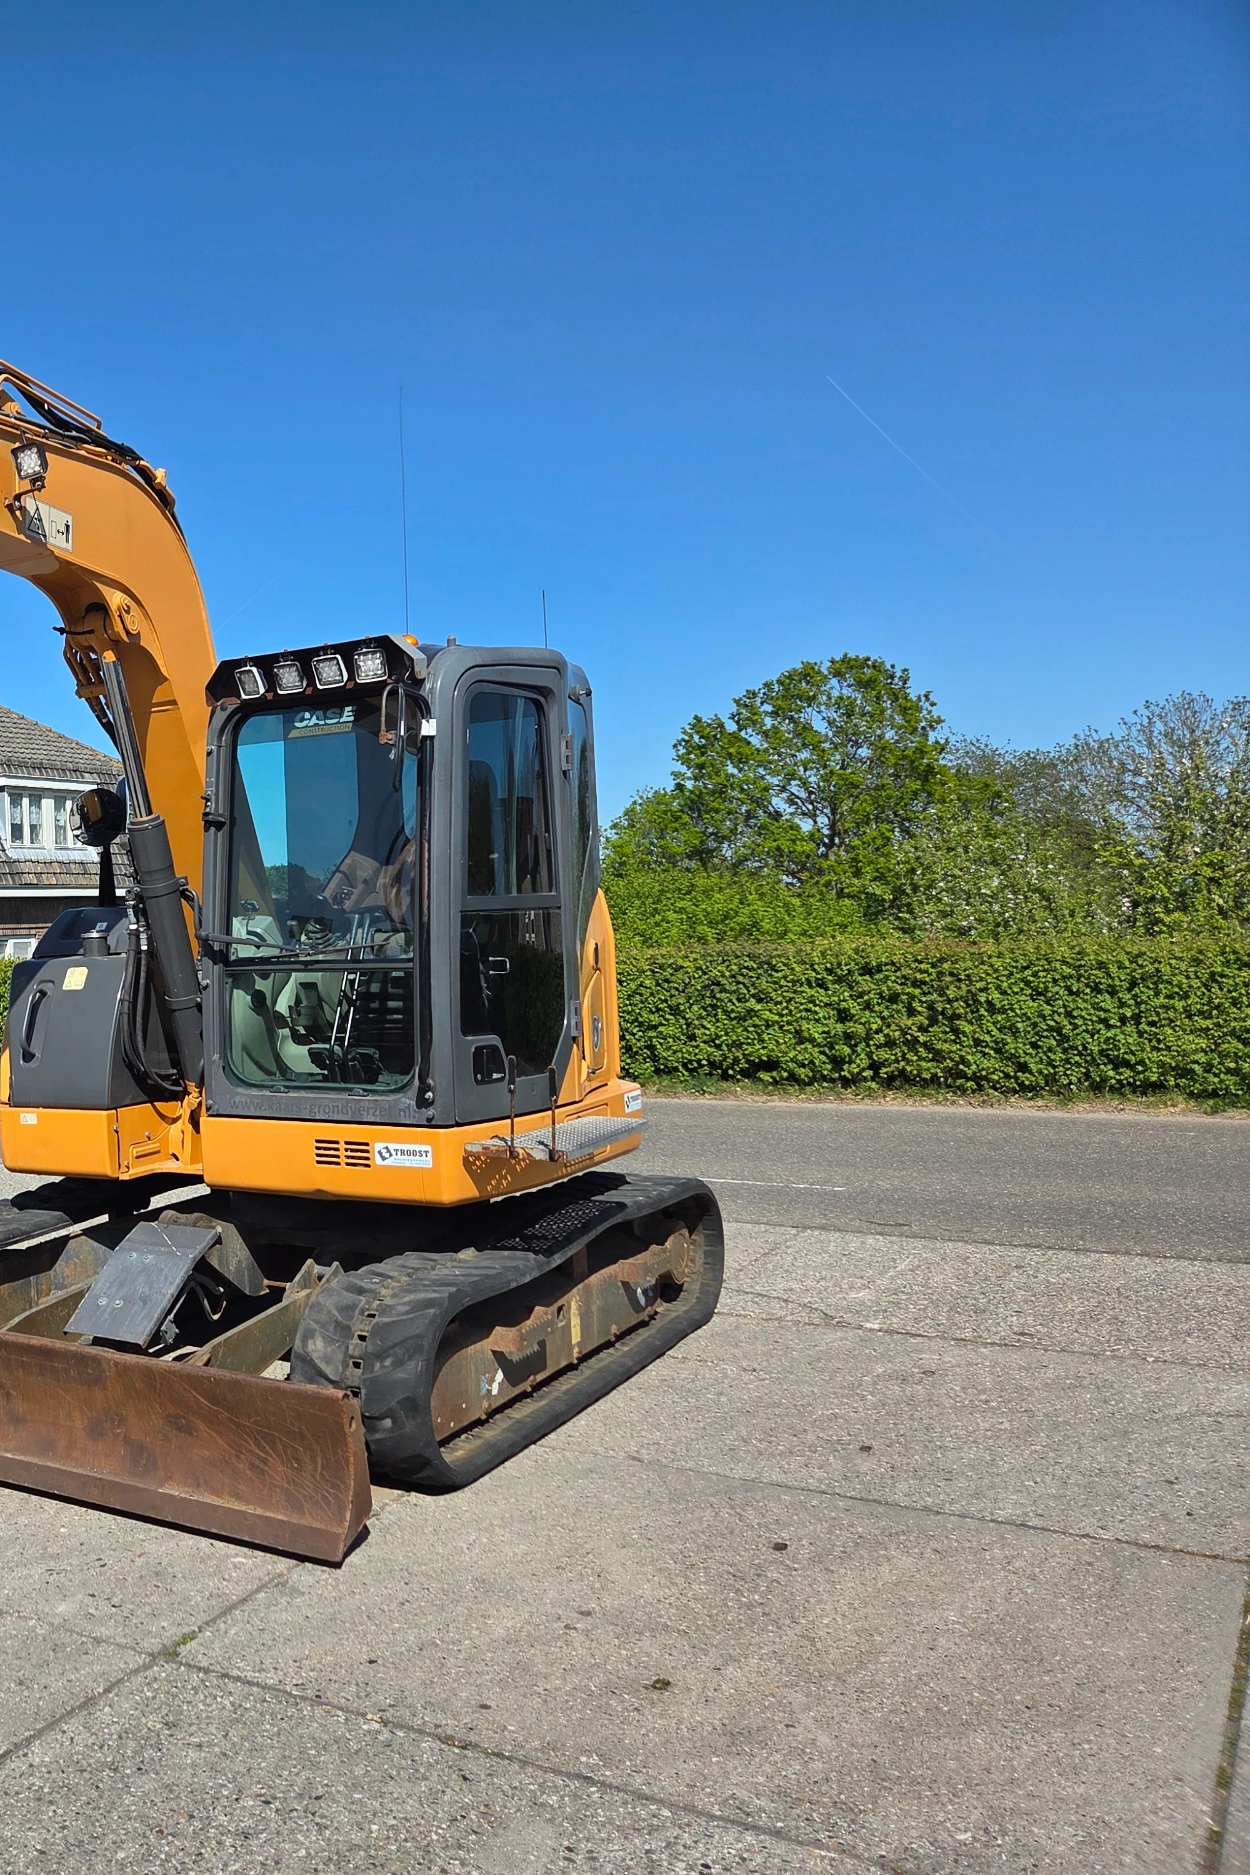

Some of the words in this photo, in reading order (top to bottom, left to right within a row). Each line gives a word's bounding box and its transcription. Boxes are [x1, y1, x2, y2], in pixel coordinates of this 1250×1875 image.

[294, 706, 356, 728] CASE
[299, 724, 351, 735] CONSTRUCTION
[393, 1148, 430, 1158] TROOST
